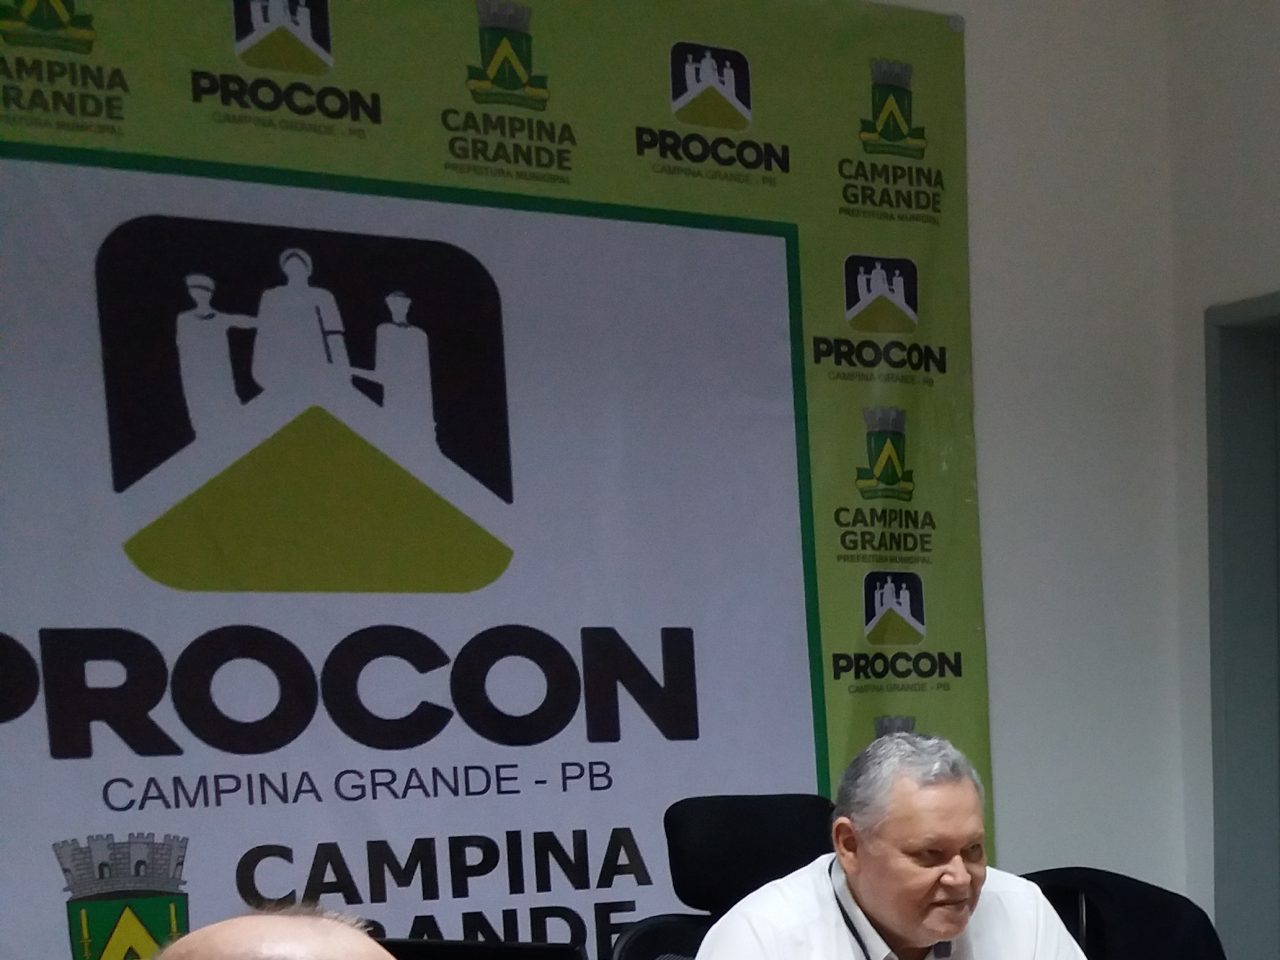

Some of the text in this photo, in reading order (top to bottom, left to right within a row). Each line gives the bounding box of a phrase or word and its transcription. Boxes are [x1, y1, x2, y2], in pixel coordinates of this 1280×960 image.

[0, 56, 130, 93] AMPINA
[0, 84, 124, 119] RANDE
[190, 69, 381, 124] PROCON
[441, 108, 577, 146] CAMPINA
[448, 136, 572, 171] GRANDE
[635, 126, 790, 174] PROCON
[838, 158, 945, 191] CAMPINA
[842, 183, 942, 214] GRANDE
[813, 336, 946, 374] PROCON
[834, 507, 936, 530] CAMPINA
[840, 530, 933, 552] GRANDE
[832, 651, 962, 680] PROCON
[102, 771, 322, 812] CAMPINA
[334, 763, 520, 801] GRANDE
[561, 760, 614, 792] PB
[235, 827, 653, 907] CAMPINA
